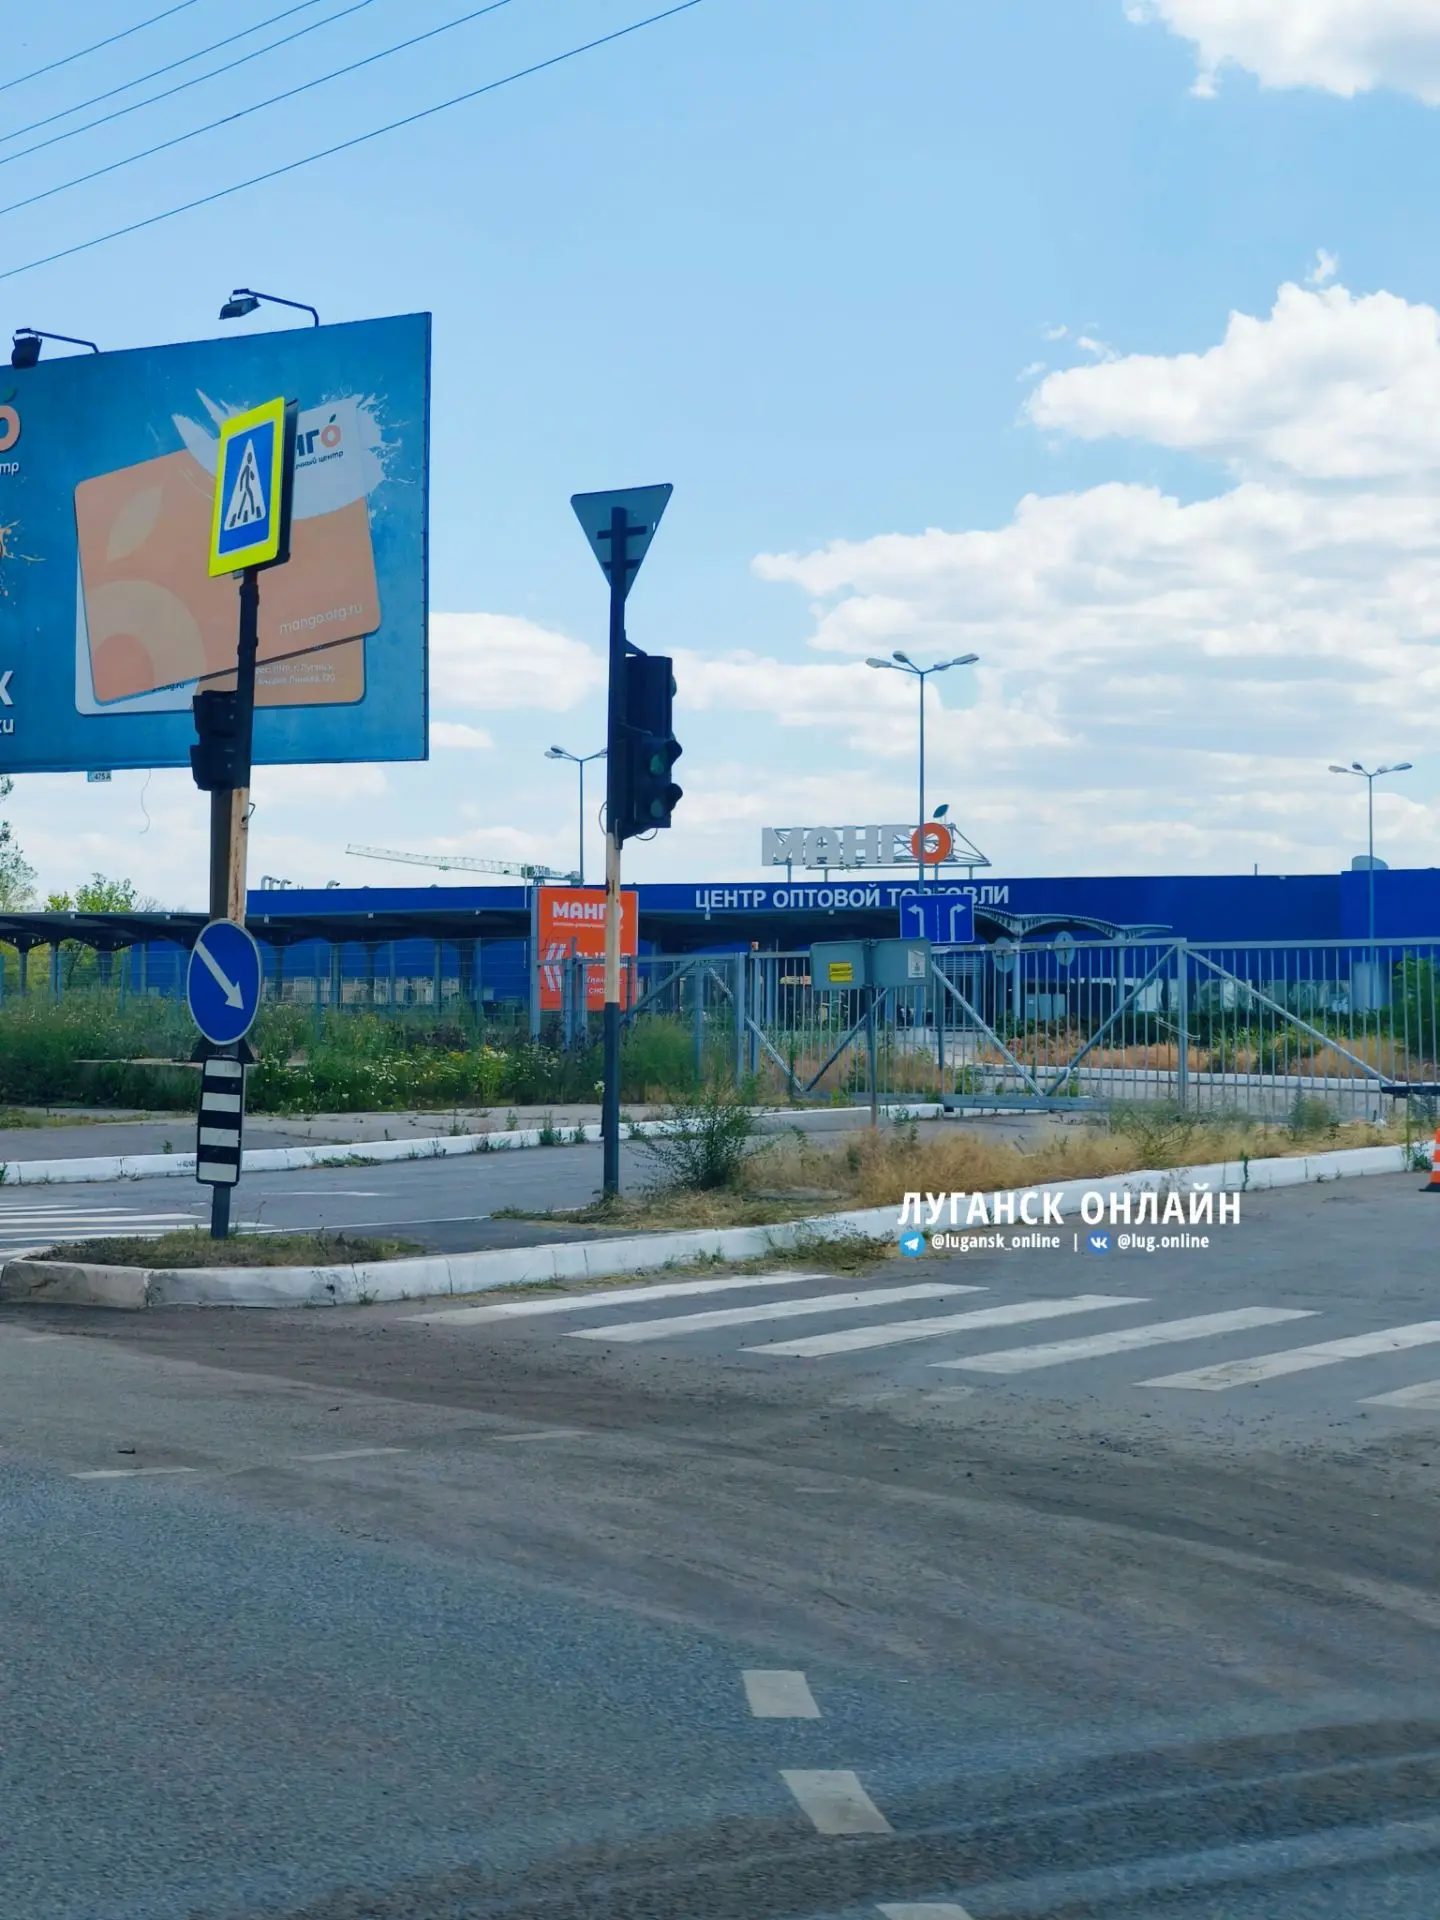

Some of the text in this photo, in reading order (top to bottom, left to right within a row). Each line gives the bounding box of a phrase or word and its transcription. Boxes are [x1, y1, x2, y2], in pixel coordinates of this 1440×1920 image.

[279, 603, 363, 635] mango.org.ru
[761, 822, 952, 866] МАНГО
[695, 889, 767, 911] ЦЕНТР
[772, 883, 881, 908] ОПТОВОЙ
